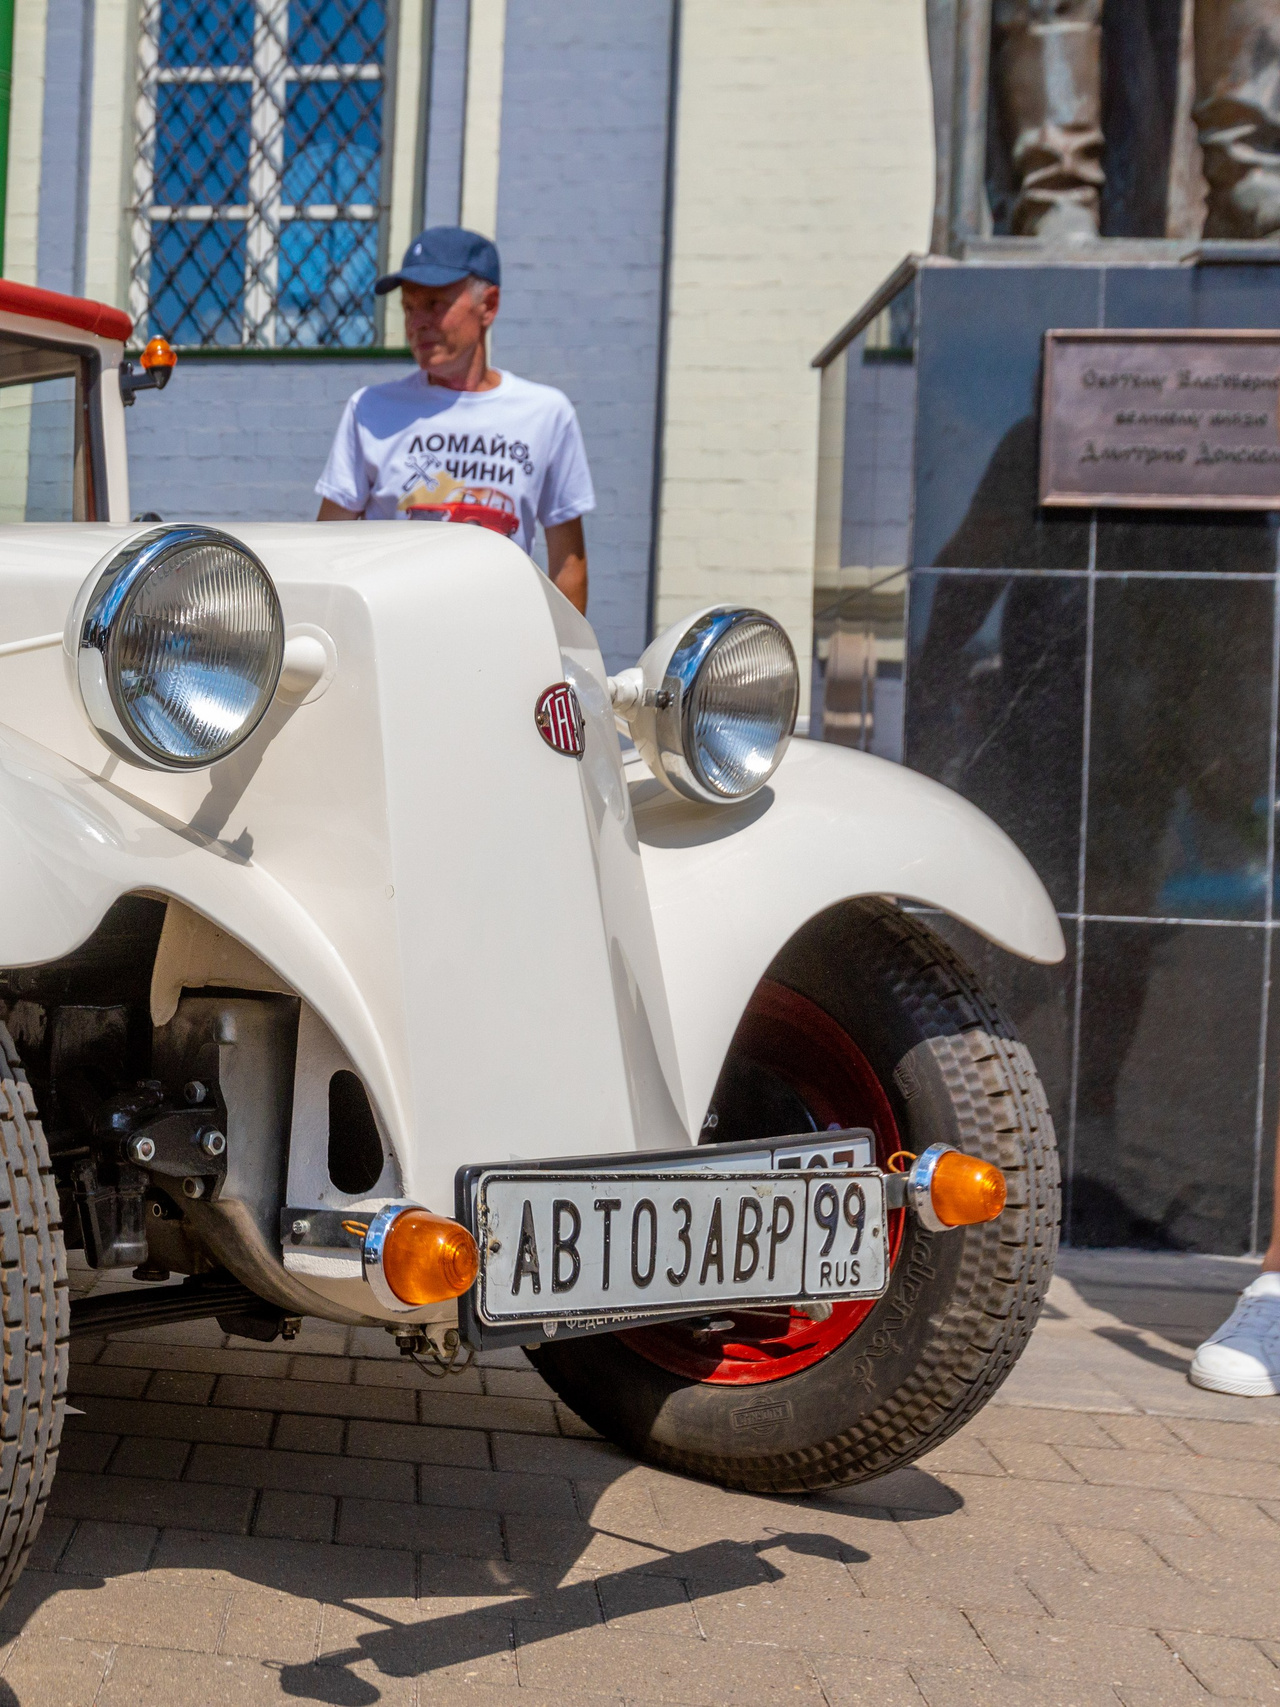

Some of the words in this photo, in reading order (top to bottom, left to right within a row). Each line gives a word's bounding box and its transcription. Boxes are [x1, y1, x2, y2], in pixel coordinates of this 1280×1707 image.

[408, 433, 507, 459] ЛОМАЙ
[445, 459, 516, 485] ЧИНИ
[813, 1181, 868, 1257] 99
[819, 1260, 862, 1289] RUS
